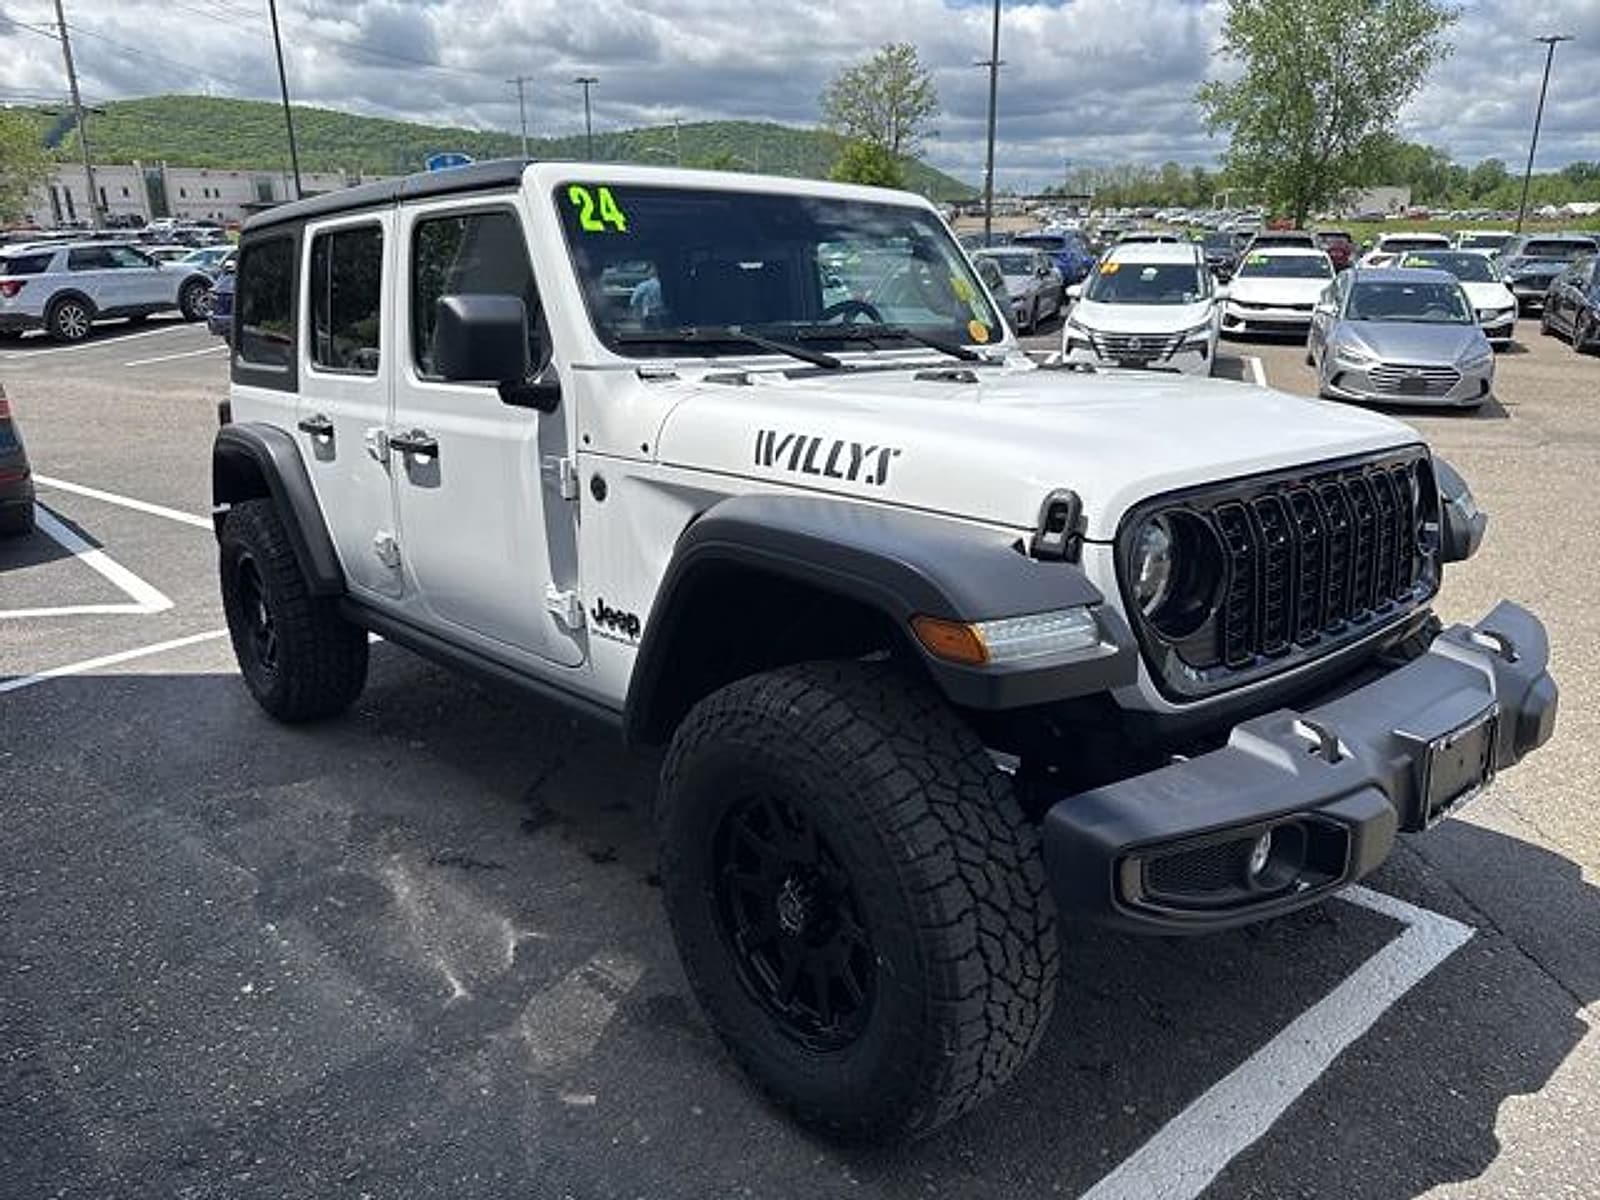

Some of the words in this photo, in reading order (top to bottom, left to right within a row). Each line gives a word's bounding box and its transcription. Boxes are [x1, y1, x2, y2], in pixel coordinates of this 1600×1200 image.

[568, 185, 627, 232] 24
[754, 429, 902, 486] WILLYS
[591, 597, 640, 640] Jeep
